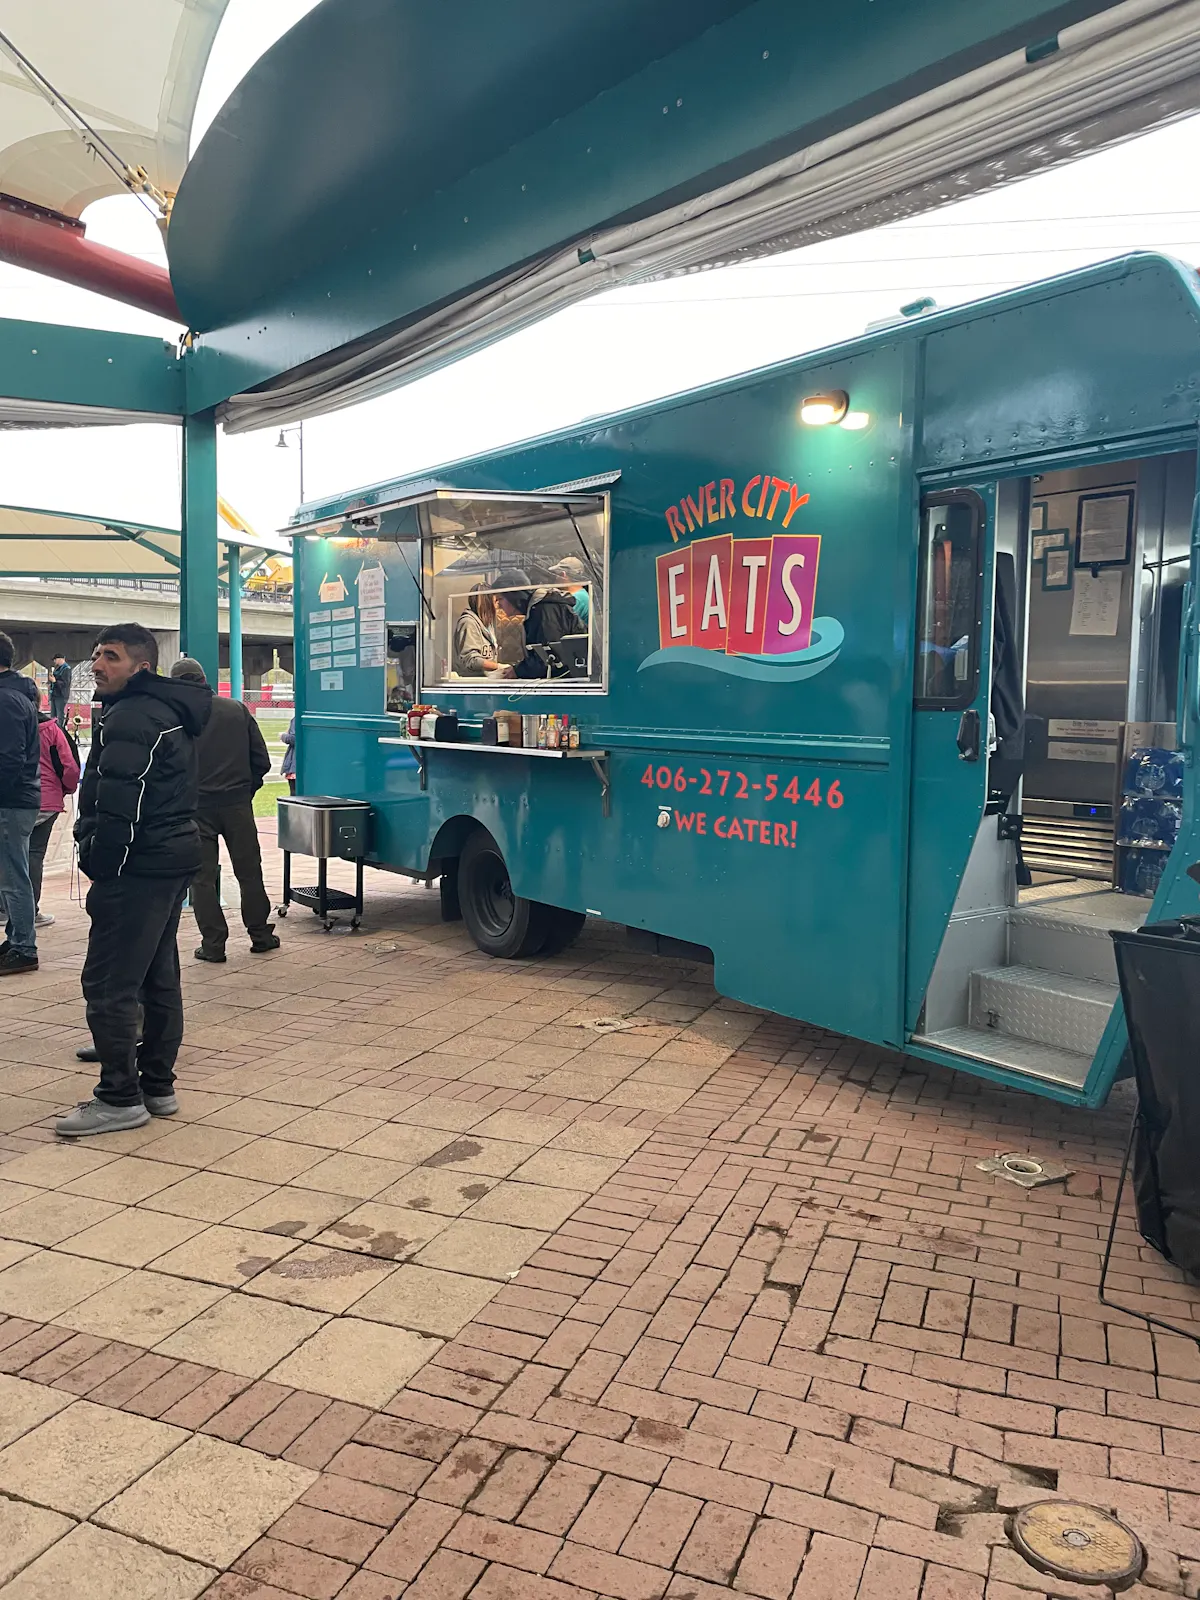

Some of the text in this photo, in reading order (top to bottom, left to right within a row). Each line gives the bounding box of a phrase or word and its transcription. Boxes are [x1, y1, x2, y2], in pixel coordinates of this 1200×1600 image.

[665, 475, 810, 543] RIVER CITY
[668, 553, 806, 639] EATS
[641, 764, 844, 809] 406-272-5446
[674, 810, 798, 849] WE CATER!
